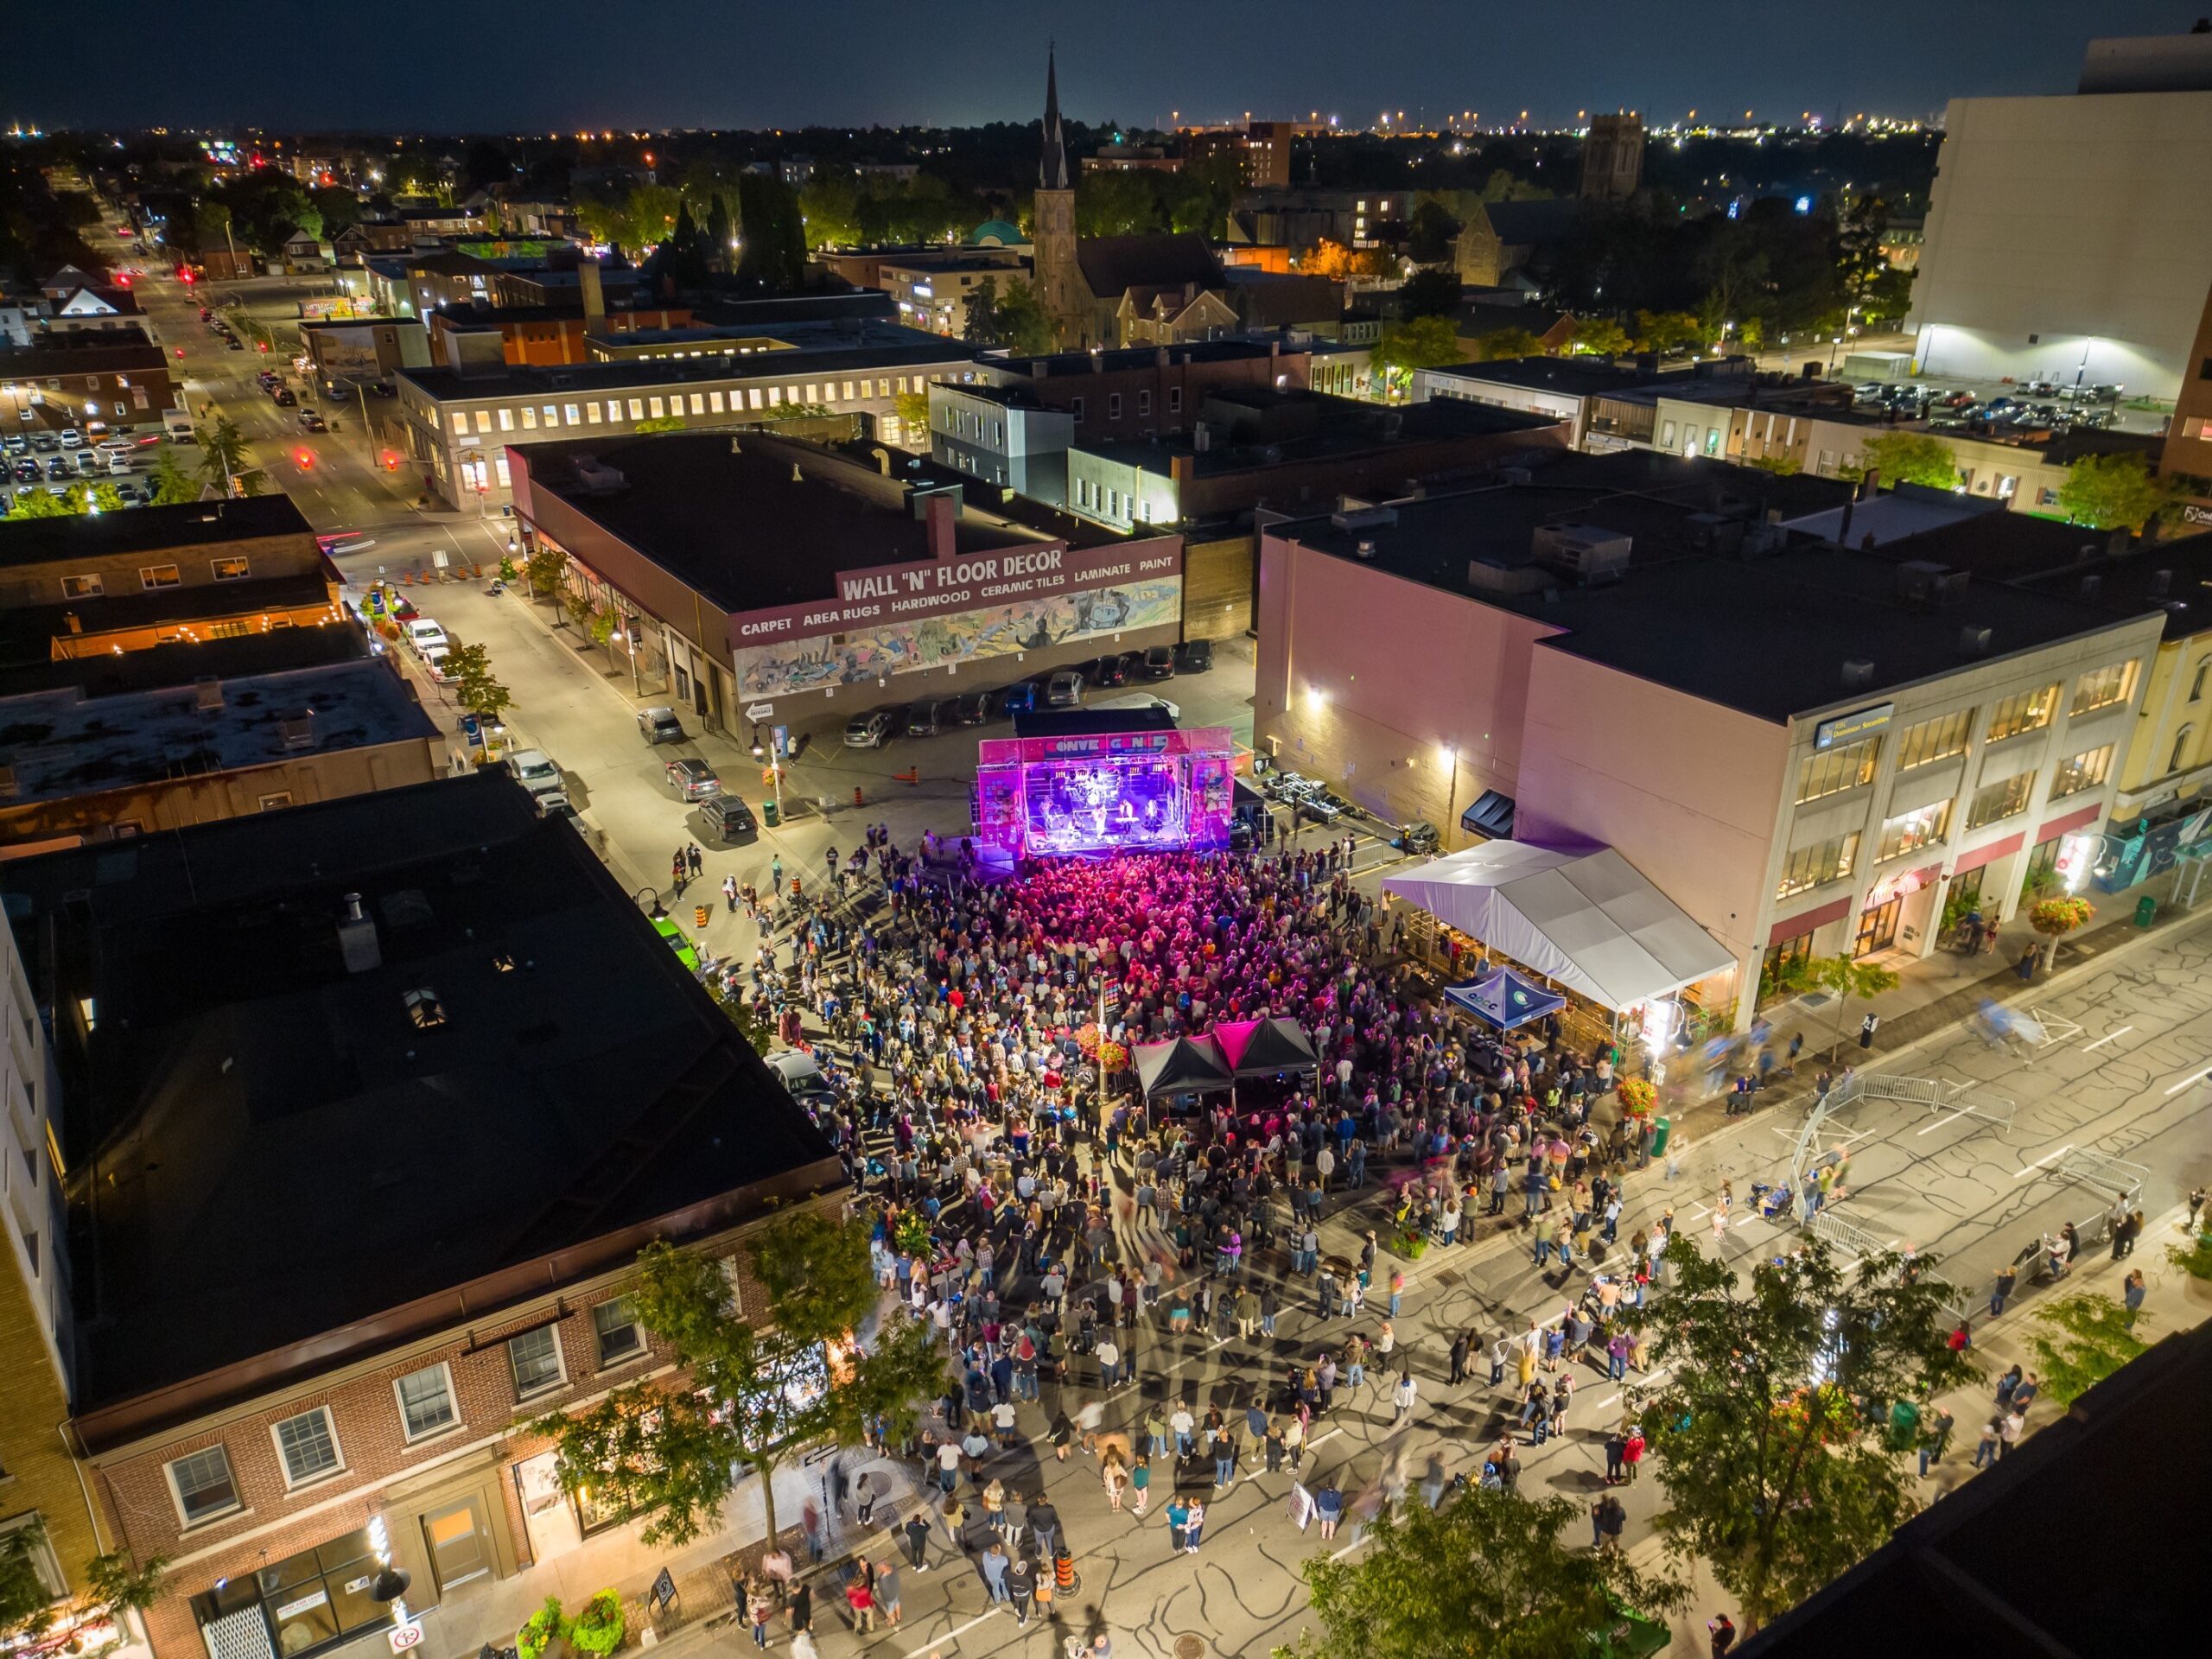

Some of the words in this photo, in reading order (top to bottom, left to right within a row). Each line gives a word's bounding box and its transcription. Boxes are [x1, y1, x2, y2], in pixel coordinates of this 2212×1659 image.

[741, 618, 791, 636] CARPET
[804, 611, 840, 626] AREA
[843, 605, 880, 620] RUGS
[892, 589, 970, 613] HARDWOOD
[981, 579, 1033, 597] CERAMIC
[1036, 575, 1065, 588] TILES
[1074, 563, 1130, 582] LAMINATE
[1140, 556, 1173, 571] PAINT
[843, 574, 898, 601] WALL
[902, 569, 931, 591] "N"
[937, 559, 997, 588] FLOOR
[1003, 550, 1062, 577] DECOR
